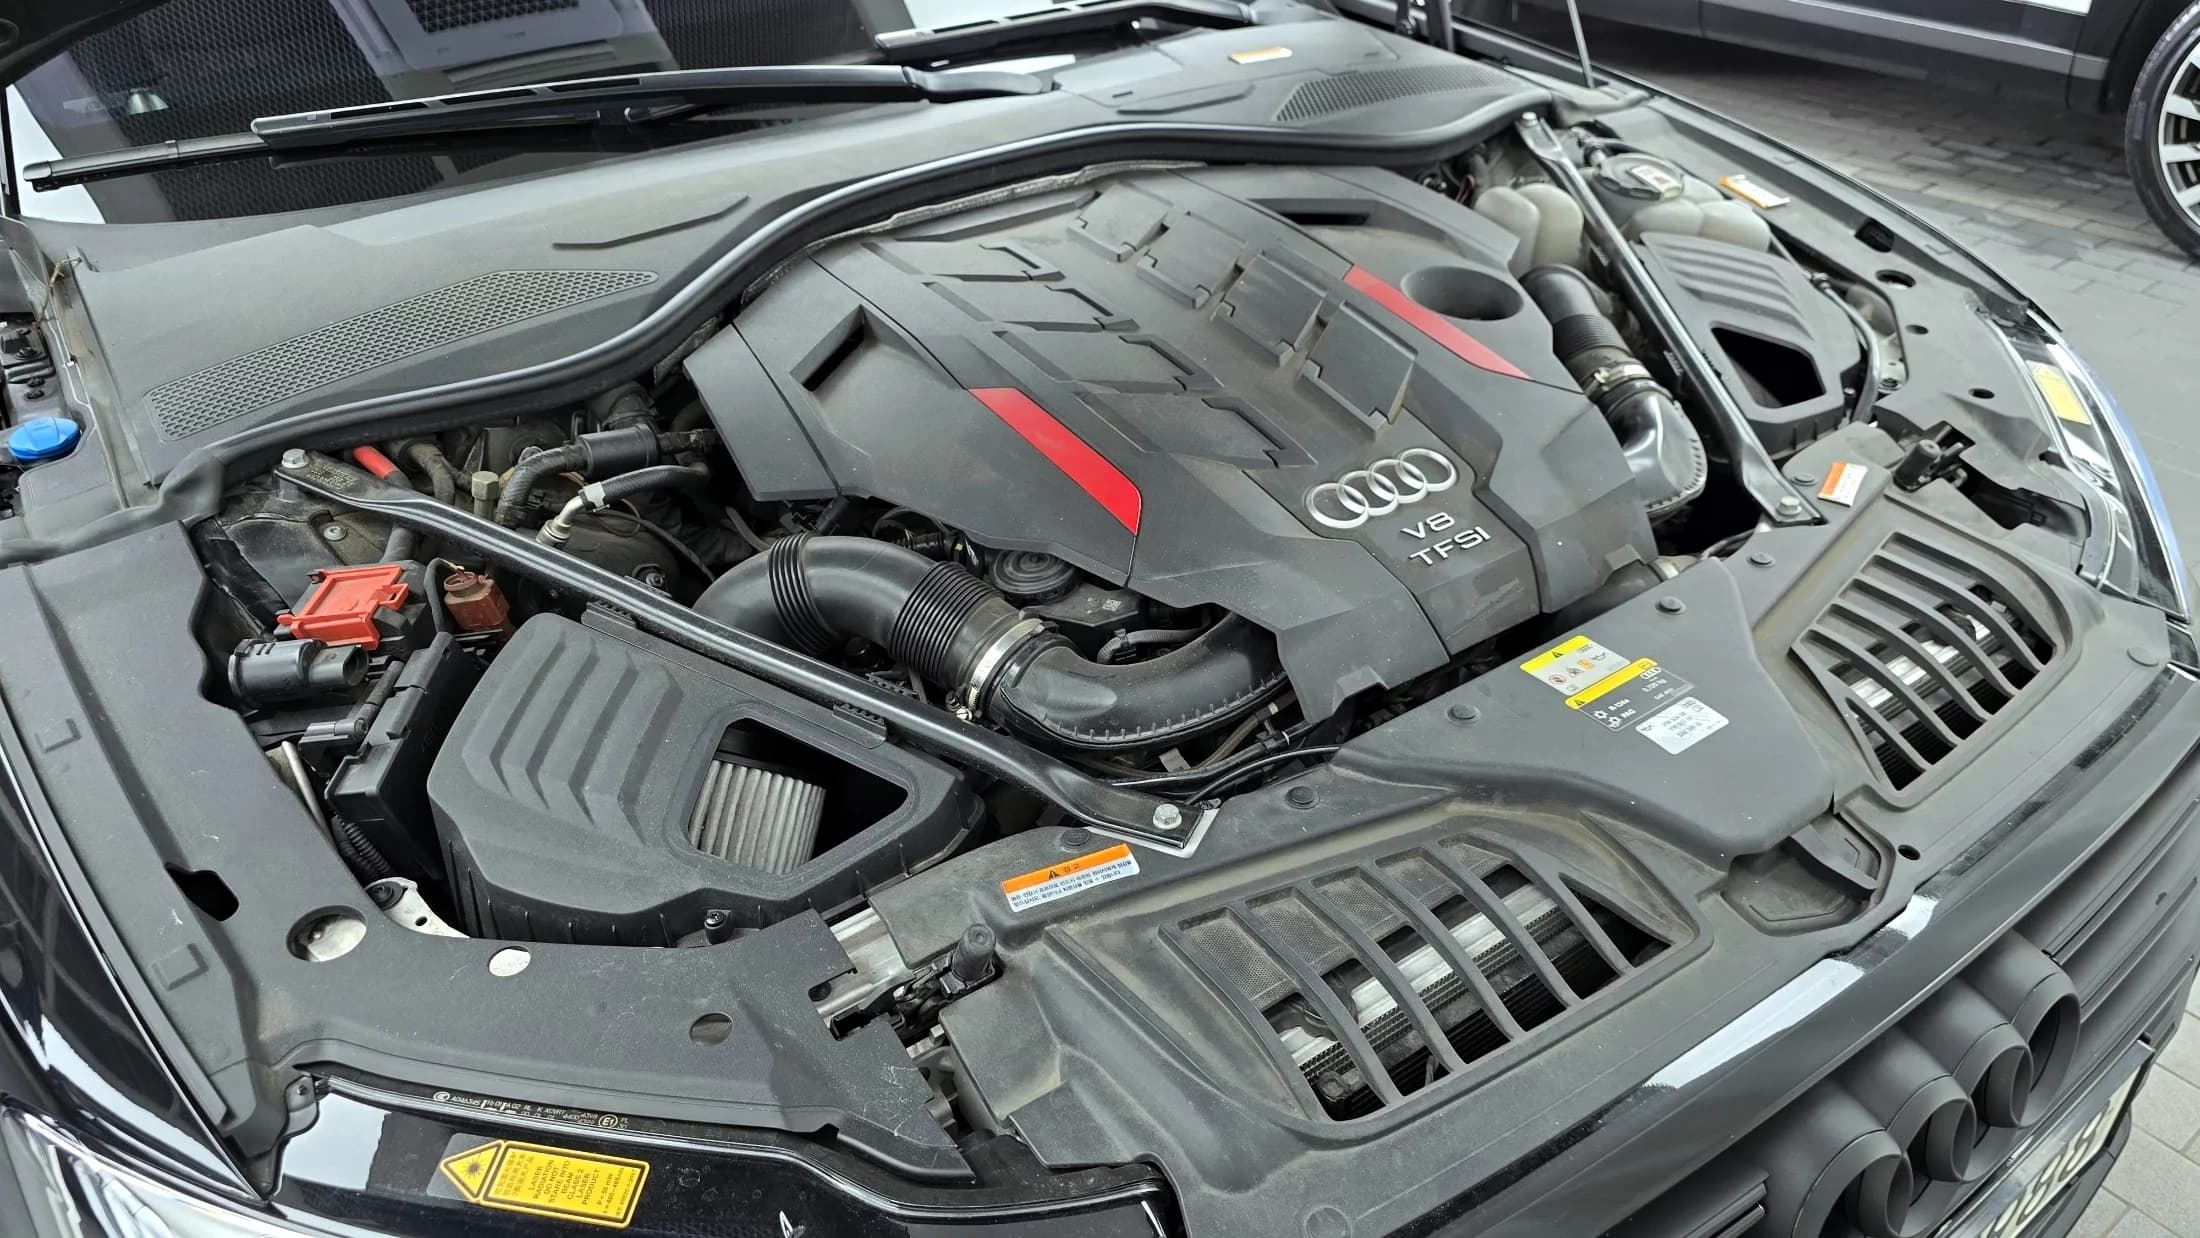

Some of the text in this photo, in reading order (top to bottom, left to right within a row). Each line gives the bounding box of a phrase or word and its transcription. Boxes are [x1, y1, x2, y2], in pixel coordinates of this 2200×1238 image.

[1400, 512, 1455, 539] V8
[1409, 526, 1491, 565] TFSI
[527, 1165, 543, 1190] LASER
[533, 1159, 554, 1199] RADIATION
[543, 1166, 559, 1194] DO NOT
[548, 1160, 570, 1203] STARE INTO
[561, 1171, 574, 1193] BEAM
[566, 1174, 582, 1199] CLASS
[575, 1172, 591, 1198] LASER
[581, 1168, 601, 1205] PRODUCT
